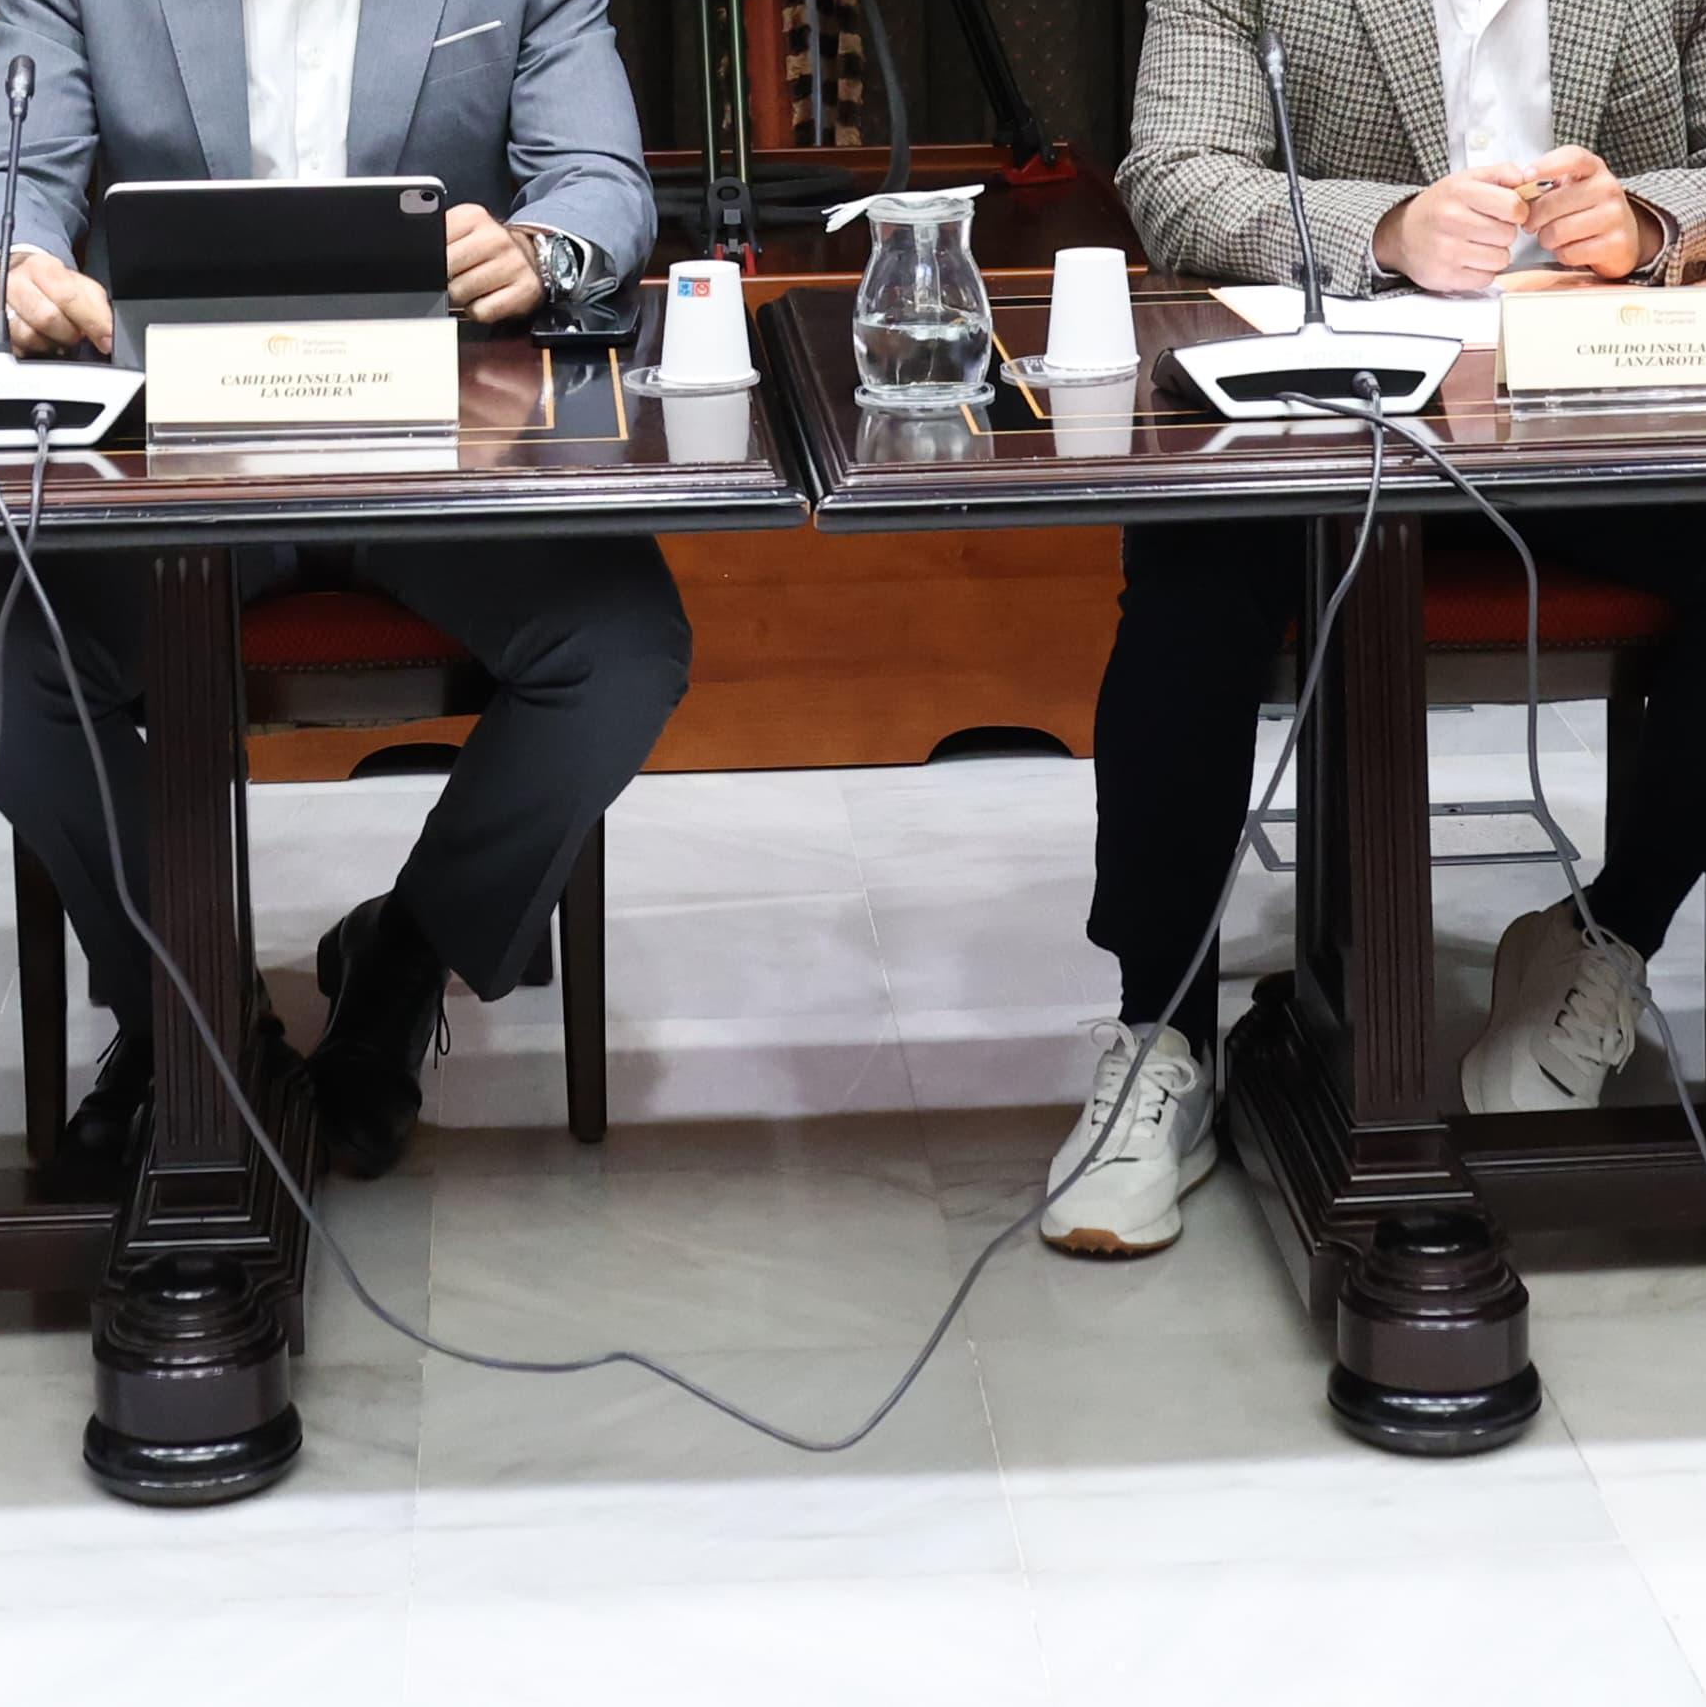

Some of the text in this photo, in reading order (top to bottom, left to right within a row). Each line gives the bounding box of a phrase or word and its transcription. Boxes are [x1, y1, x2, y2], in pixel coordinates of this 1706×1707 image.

[1576, 343, 1646, 355] CABILDO
[1615, 355, 1706, 367] LANZAROTE
[220, 372, 392, 386] CABILDO INSULAR DE
[260, 386, 353, 398] LA GOMERA
